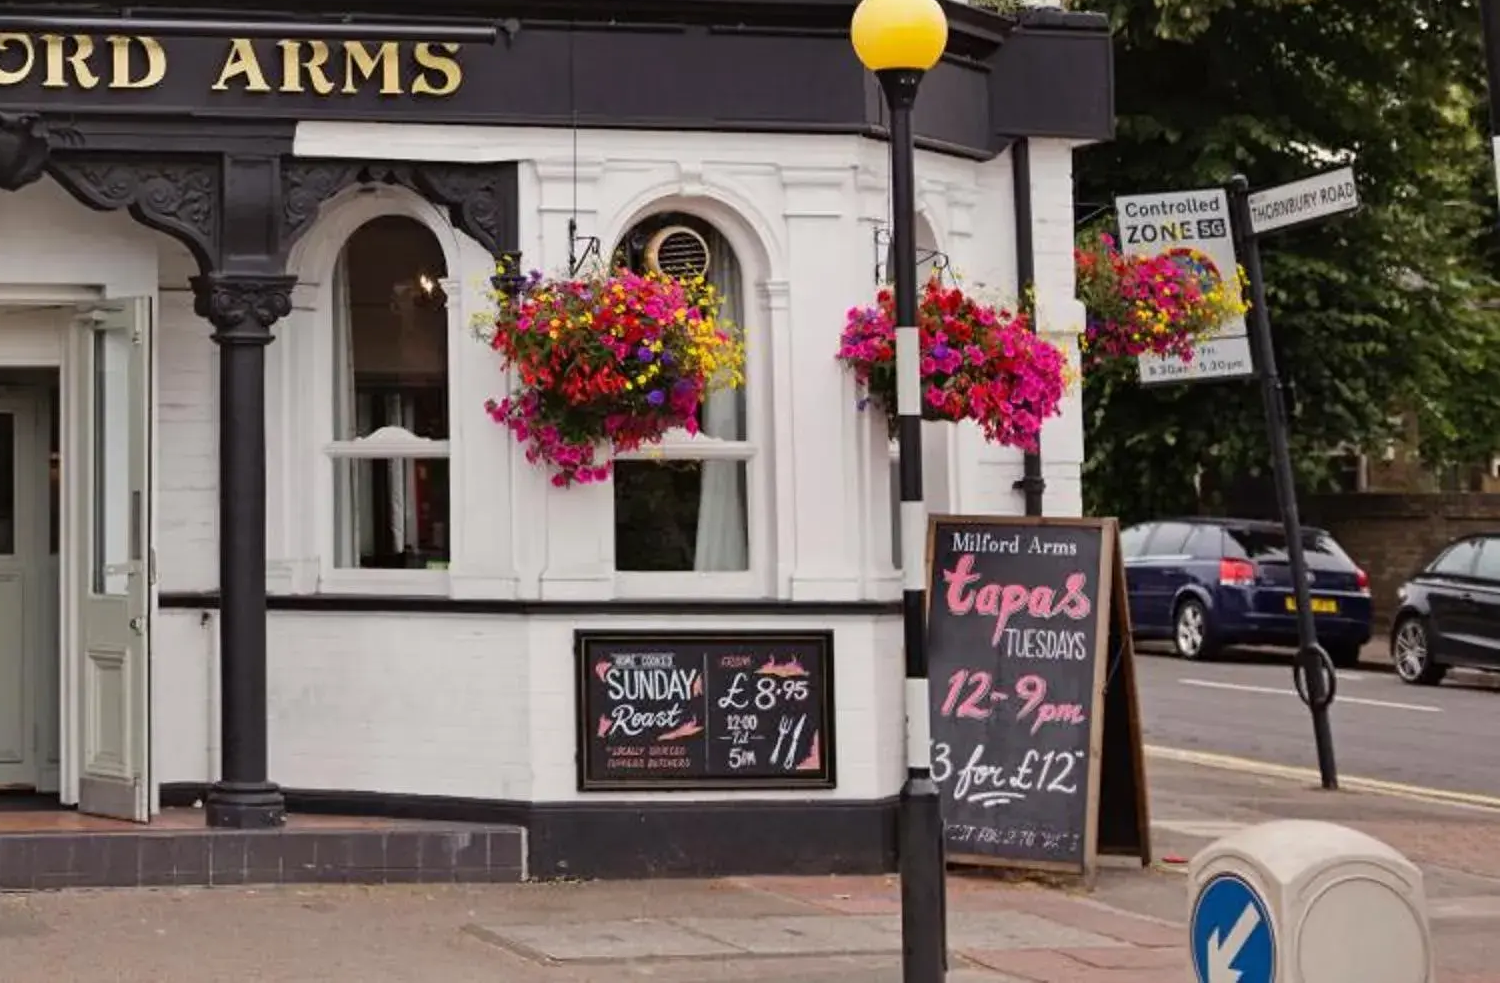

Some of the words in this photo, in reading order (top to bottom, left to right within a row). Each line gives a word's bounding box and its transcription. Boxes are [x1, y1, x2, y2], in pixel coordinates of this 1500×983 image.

[211, 38, 464, 97] ARMS
[1125, 198, 1221, 218] Controlled
[1252, 191, 1318, 222] THORNBURY
[1319, 181, 1355, 204] ROAD
[1126, 221, 1194, 244] ZONE
[952, 532, 1019, 554] Milford
[1028, 536, 1077, 555] Arms
[943, 554, 1091, 648] tapas
[1004, 628, 1087, 660] TUESDAYS
[606, 669, 697, 700] SUNDAY
[609, 703, 684, 736] Roast
[930, 742, 953, 782] 3
[954, 744, 1006, 800] for
